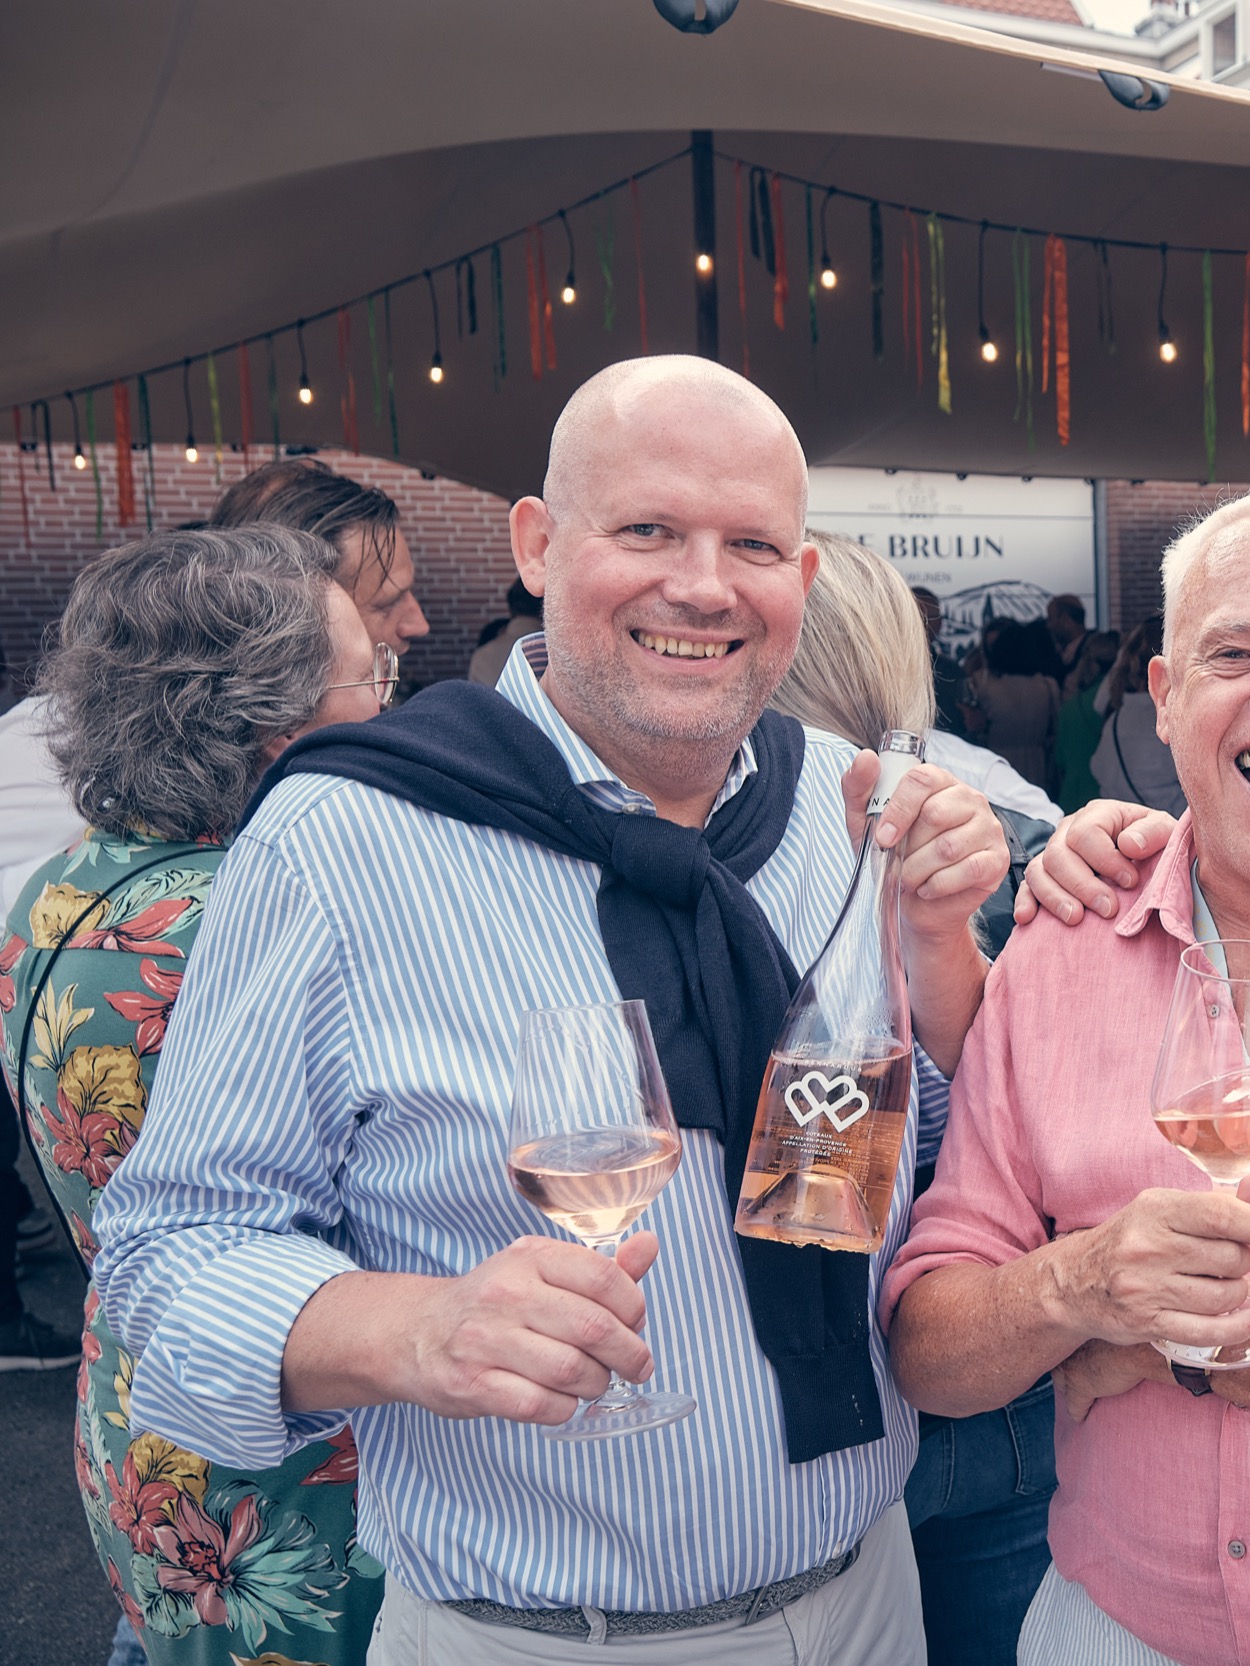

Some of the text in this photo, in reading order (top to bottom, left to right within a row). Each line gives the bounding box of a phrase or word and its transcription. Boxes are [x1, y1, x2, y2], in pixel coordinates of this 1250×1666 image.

[889, 533, 1004, 559] BRUIJN
[806, 1131, 833, 1139] COTEAUX
[782, 1140, 853, 1154] APPELLATION D'ORIGINE
